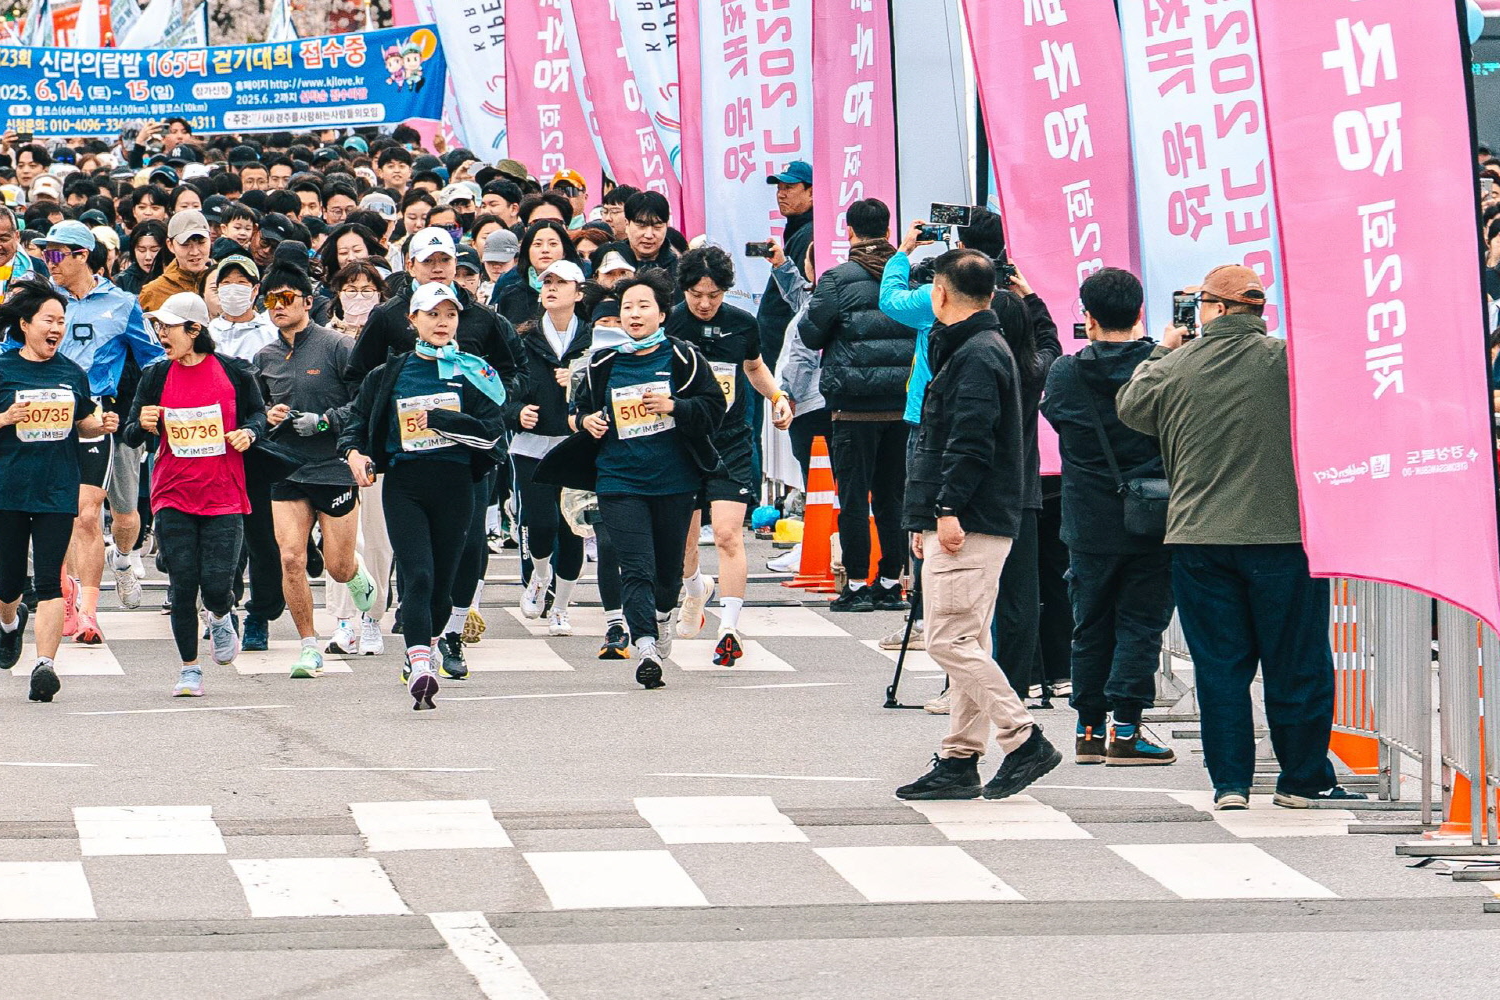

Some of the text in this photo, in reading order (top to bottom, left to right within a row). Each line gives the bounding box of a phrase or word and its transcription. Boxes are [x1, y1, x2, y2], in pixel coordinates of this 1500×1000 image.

[39, 51, 143, 79] 신라의달밤
[147, 49, 208, 78] 165리
[212, 43, 293, 75] 걷기대회
[299, 34, 367, 70] 접수중
[35, 79, 84, 102] 6.14
[23, 408, 69, 423] 50735
[620, 403, 646, 420] 510
[171, 424, 218, 440] 50736
